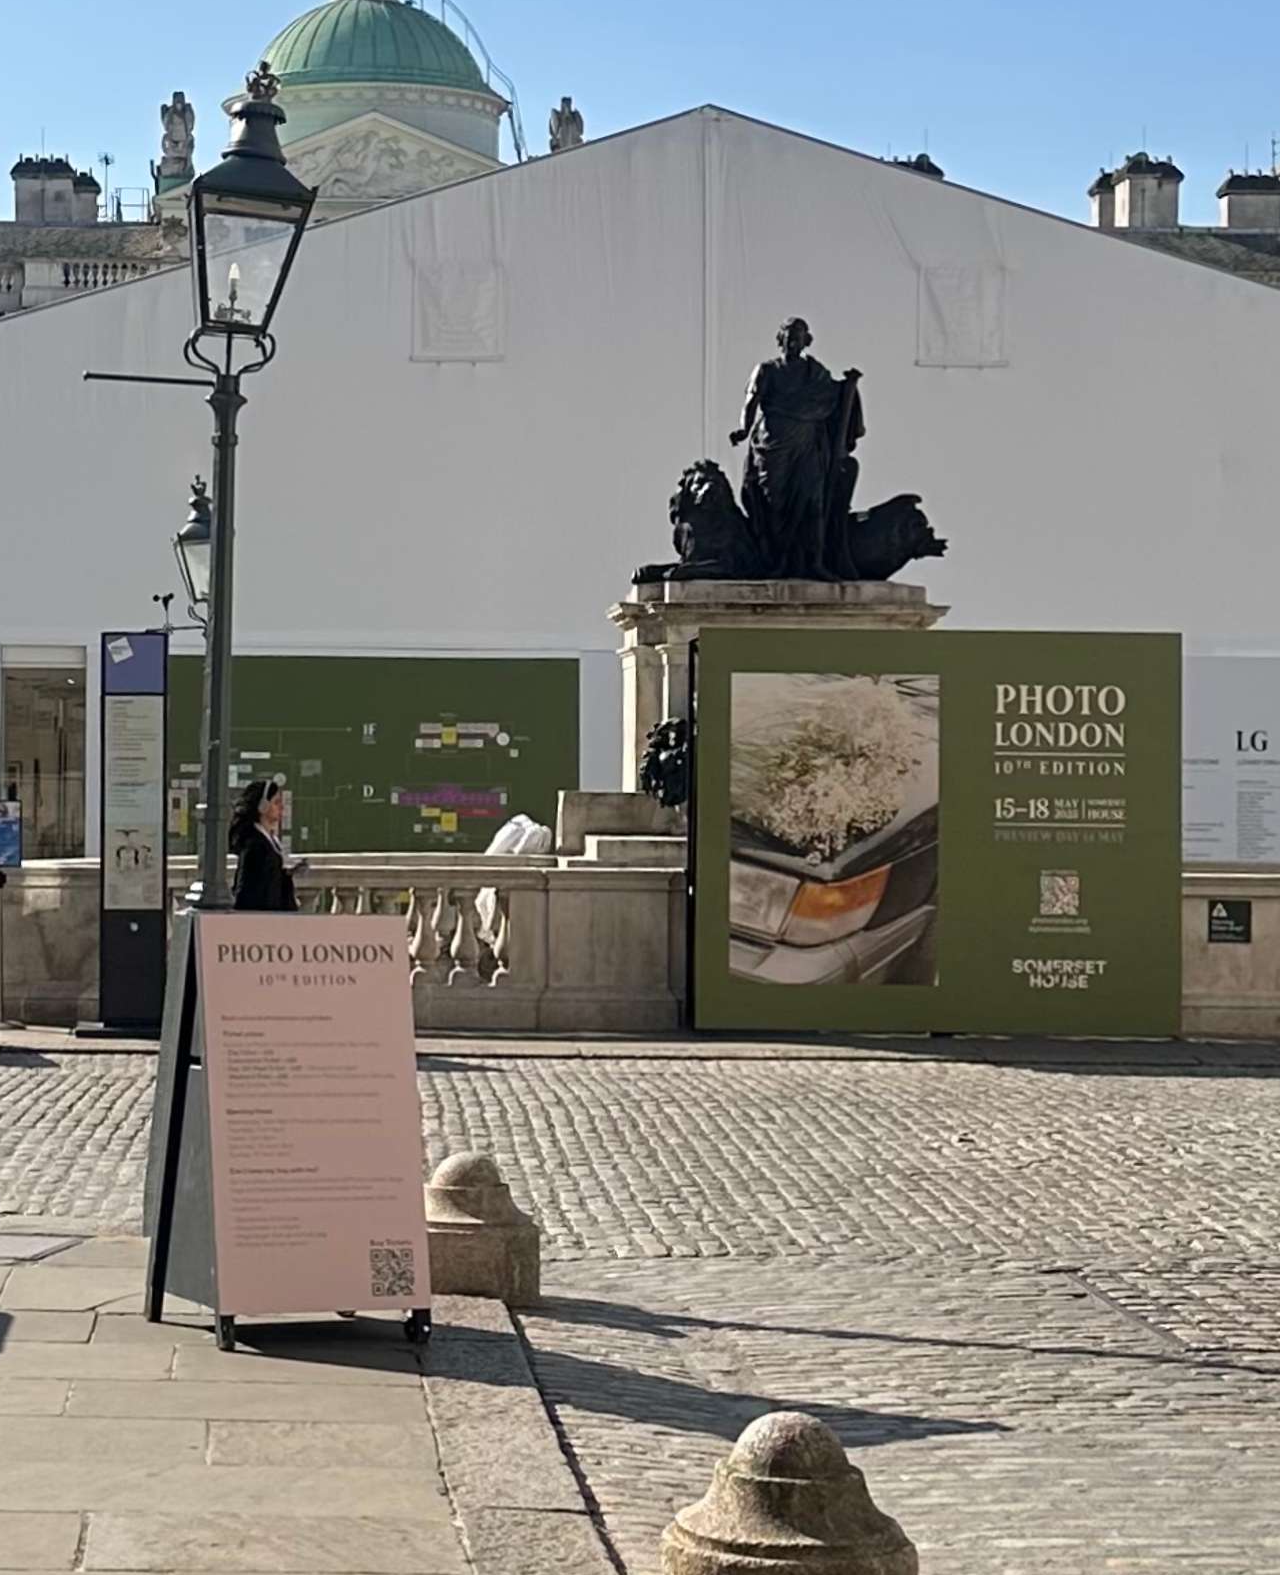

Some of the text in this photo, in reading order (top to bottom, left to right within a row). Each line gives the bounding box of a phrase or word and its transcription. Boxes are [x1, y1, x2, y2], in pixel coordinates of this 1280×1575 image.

[995, 684, 1126, 716] PHOTO
[995, 722, 1125, 748] LONDON
[1236, 730, 1268, 752] LG
[994, 760, 1126, 776] 10TH EDITION
[363, 784, 375, 798] D
[1053, 798, 1080, 808] MAY
[1087, 808, 1126, 820] HOUSE
[217, 943, 394, 964] PHOTO LONDON
[1011, 958, 1108, 975] SOMERSET
[292, 973, 358, 987] EDITION
[1029, 974, 1090, 989] HOUSE
